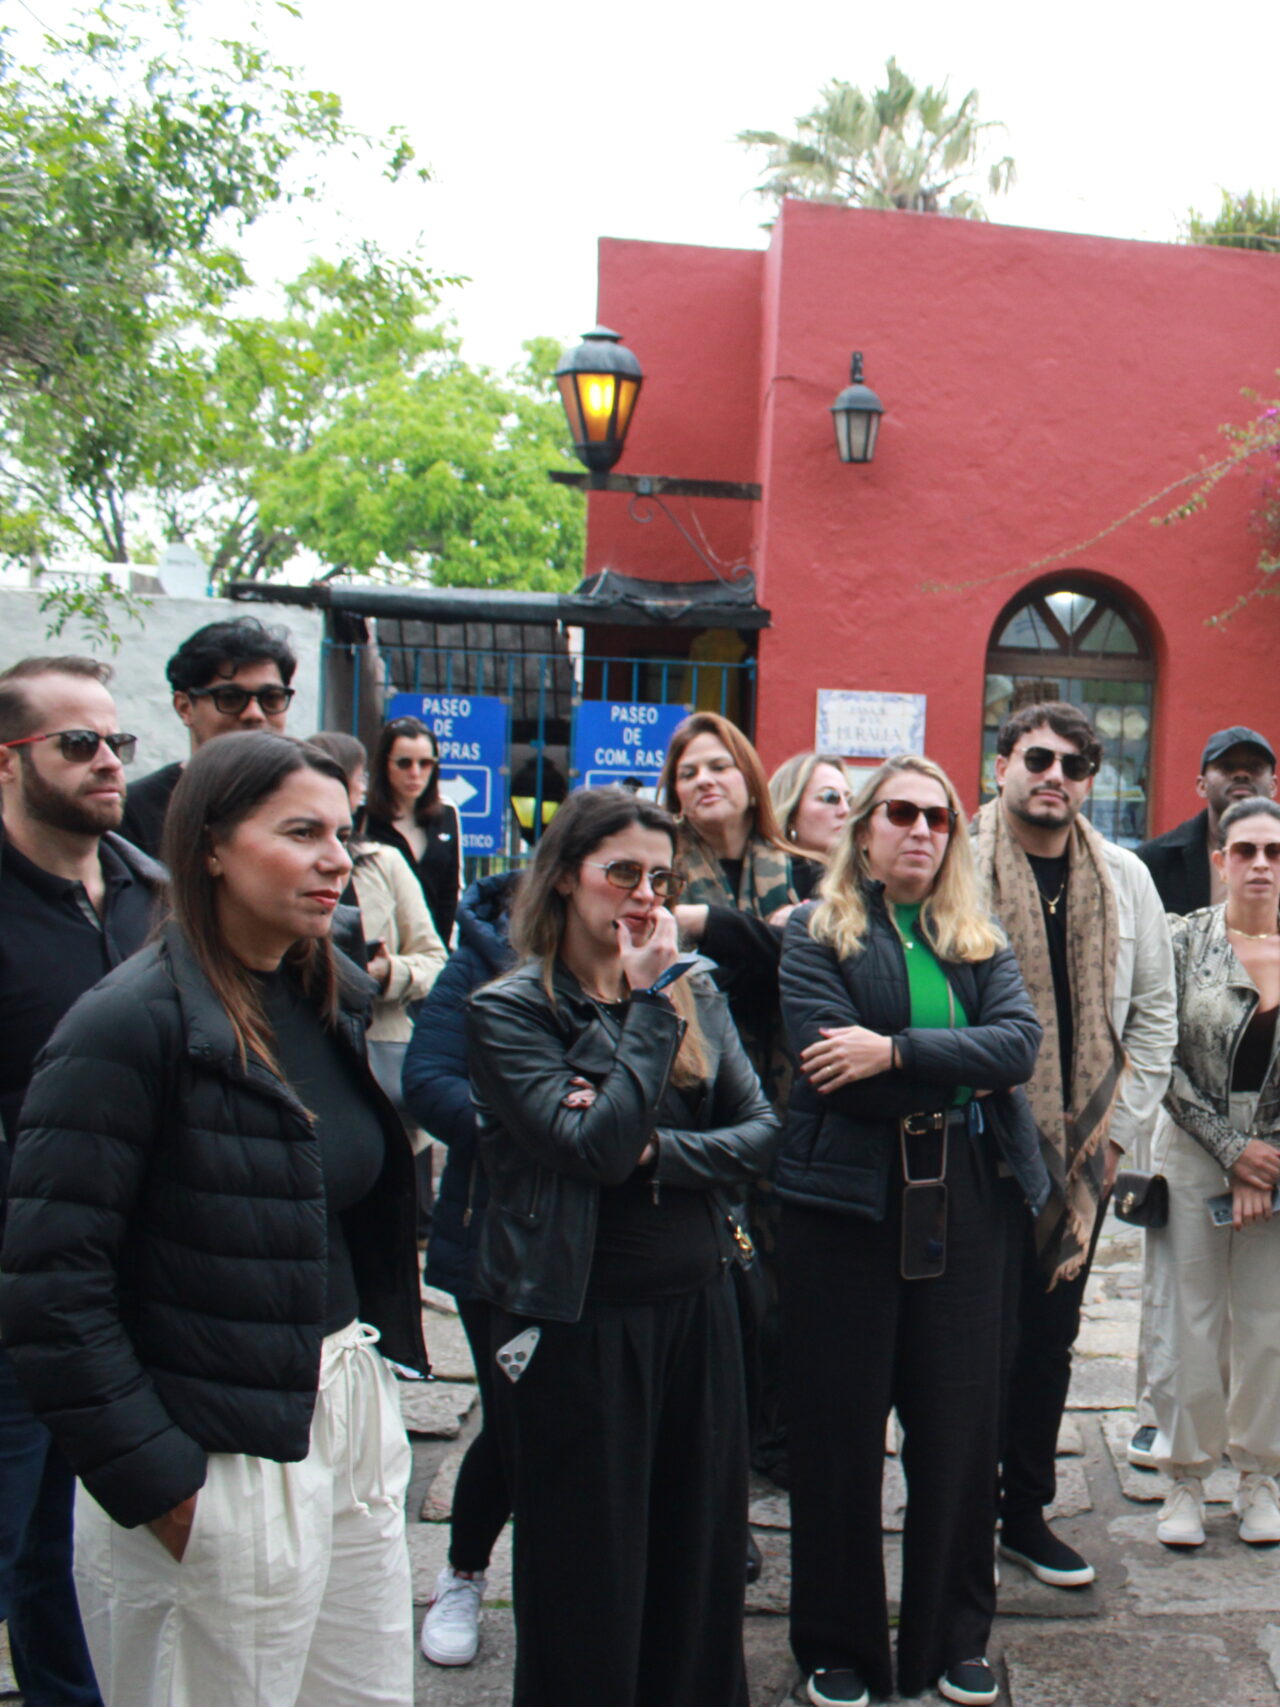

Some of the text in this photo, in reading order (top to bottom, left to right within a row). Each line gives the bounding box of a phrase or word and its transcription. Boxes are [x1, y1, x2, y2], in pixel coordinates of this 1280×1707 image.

[422, 697, 471, 717] PASEO
[610, 705, 659, 724] PASEO
[433, 718, 454, 737] DE
[623, 727, 642, 746] DE
[438, 741, 481, 761] PRAS
[460, 833, 494, 848] STICO
